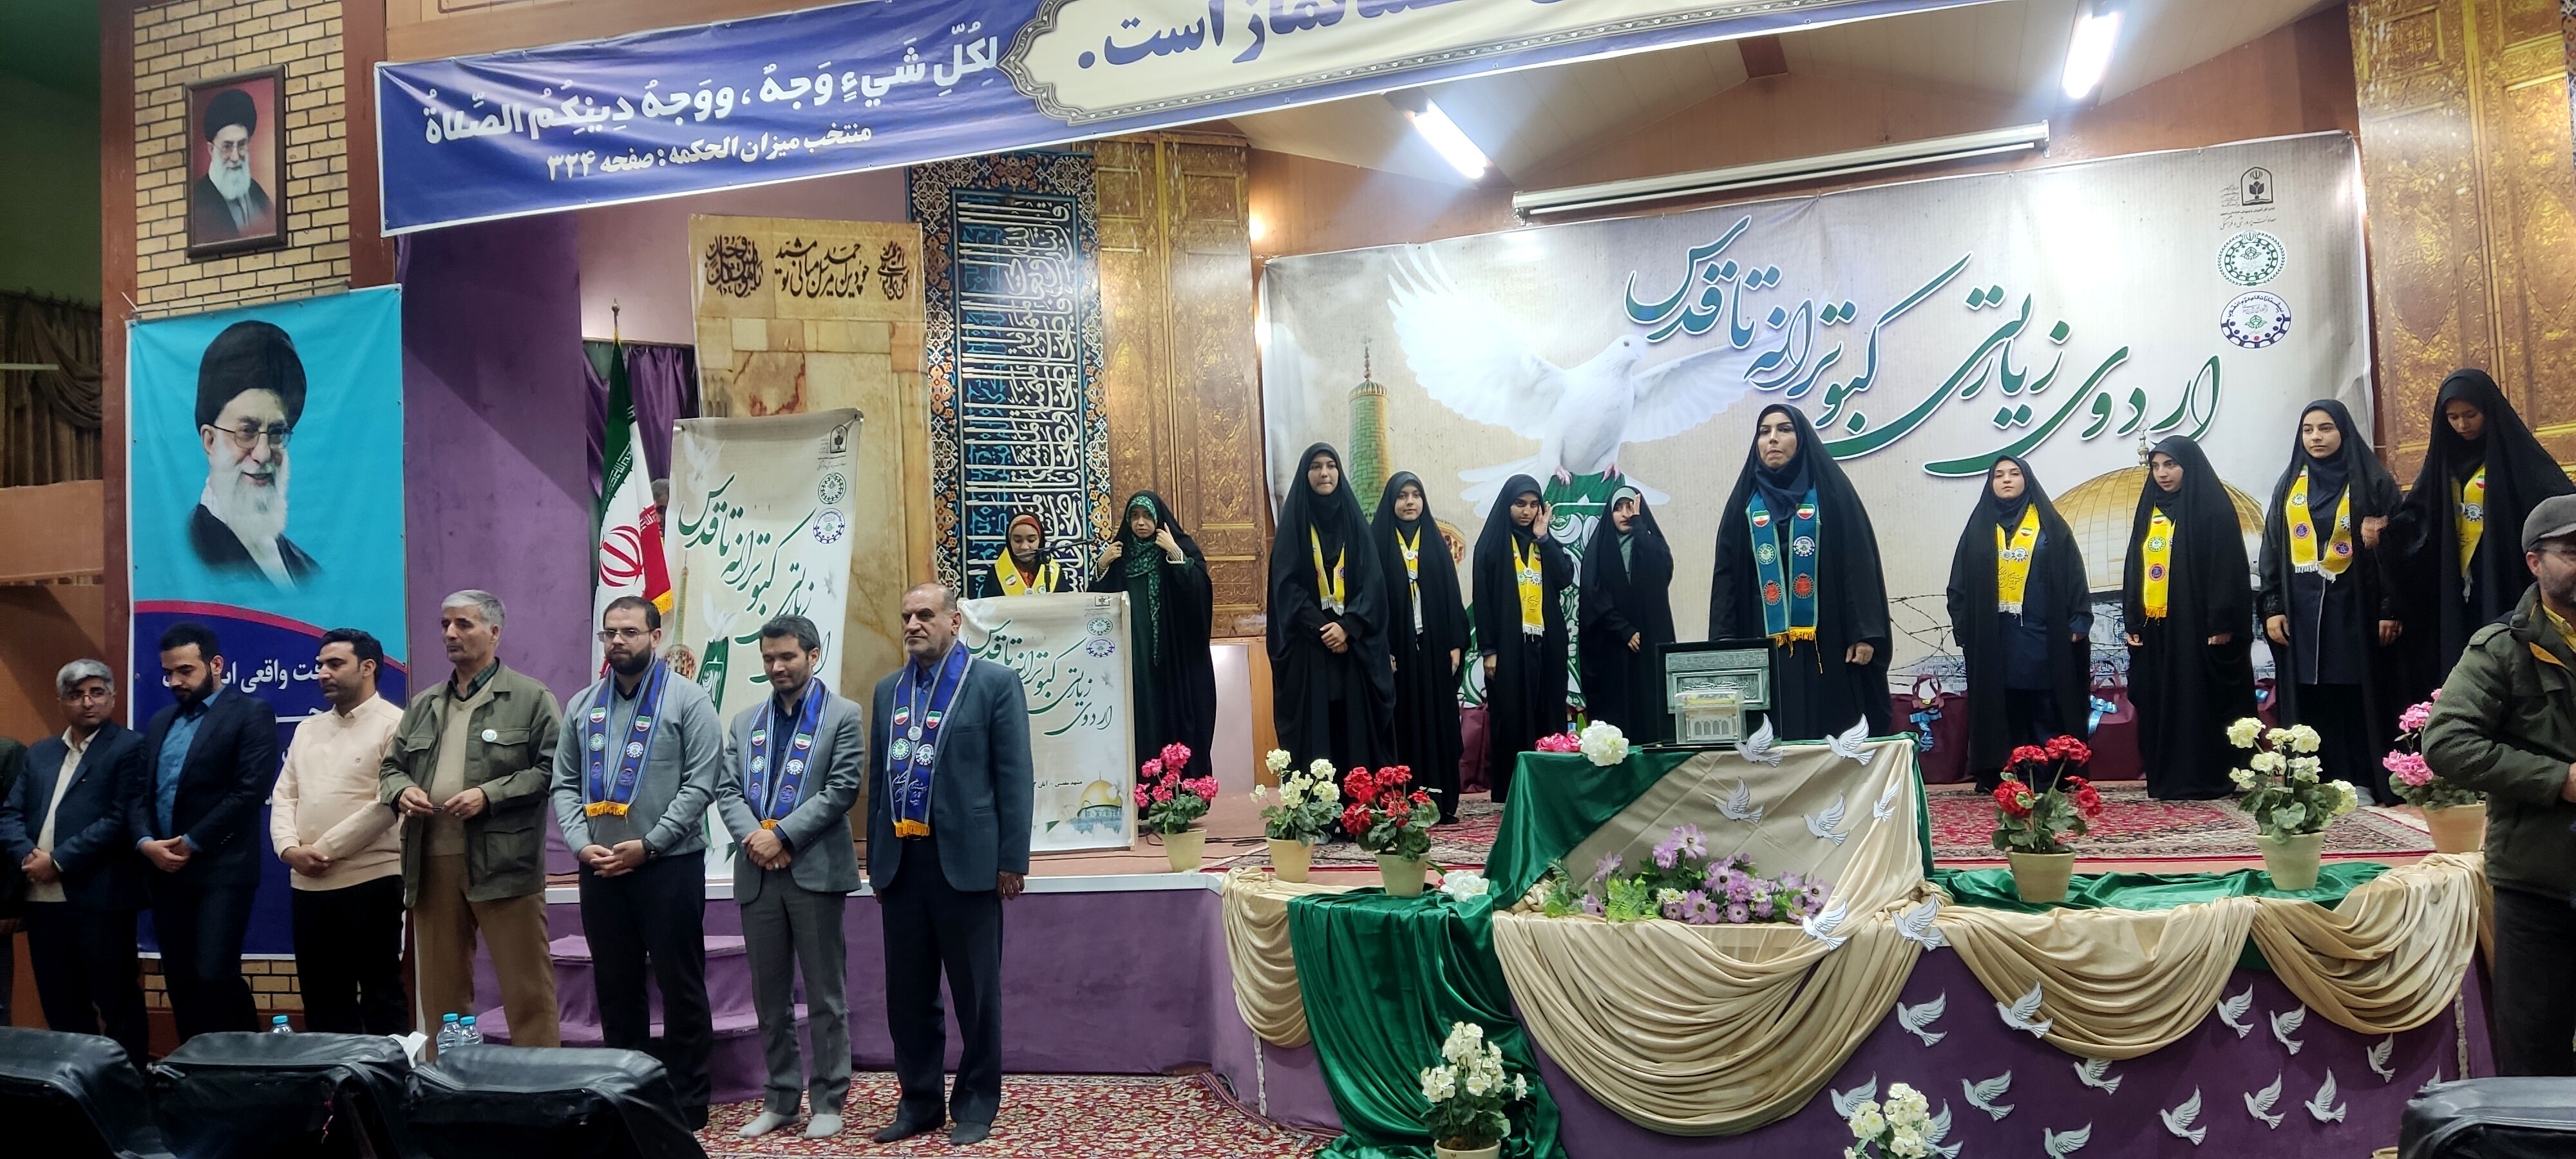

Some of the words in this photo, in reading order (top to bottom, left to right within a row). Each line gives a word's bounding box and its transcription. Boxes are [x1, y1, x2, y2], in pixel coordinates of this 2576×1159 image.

[598, 146, 654, 173] صفحه
[802, 122, 873, 155] منتخب
[1624, 214, 1753, 344] قدس
[1820, 284, 2071, 461] زیارتی
[1923, 344, 2222, 477] اردوی
[677, 474, 736, 549] قدس
[240, 657, 288, 693] واقعی
[1043, 701, 1113, 736] اردوی
